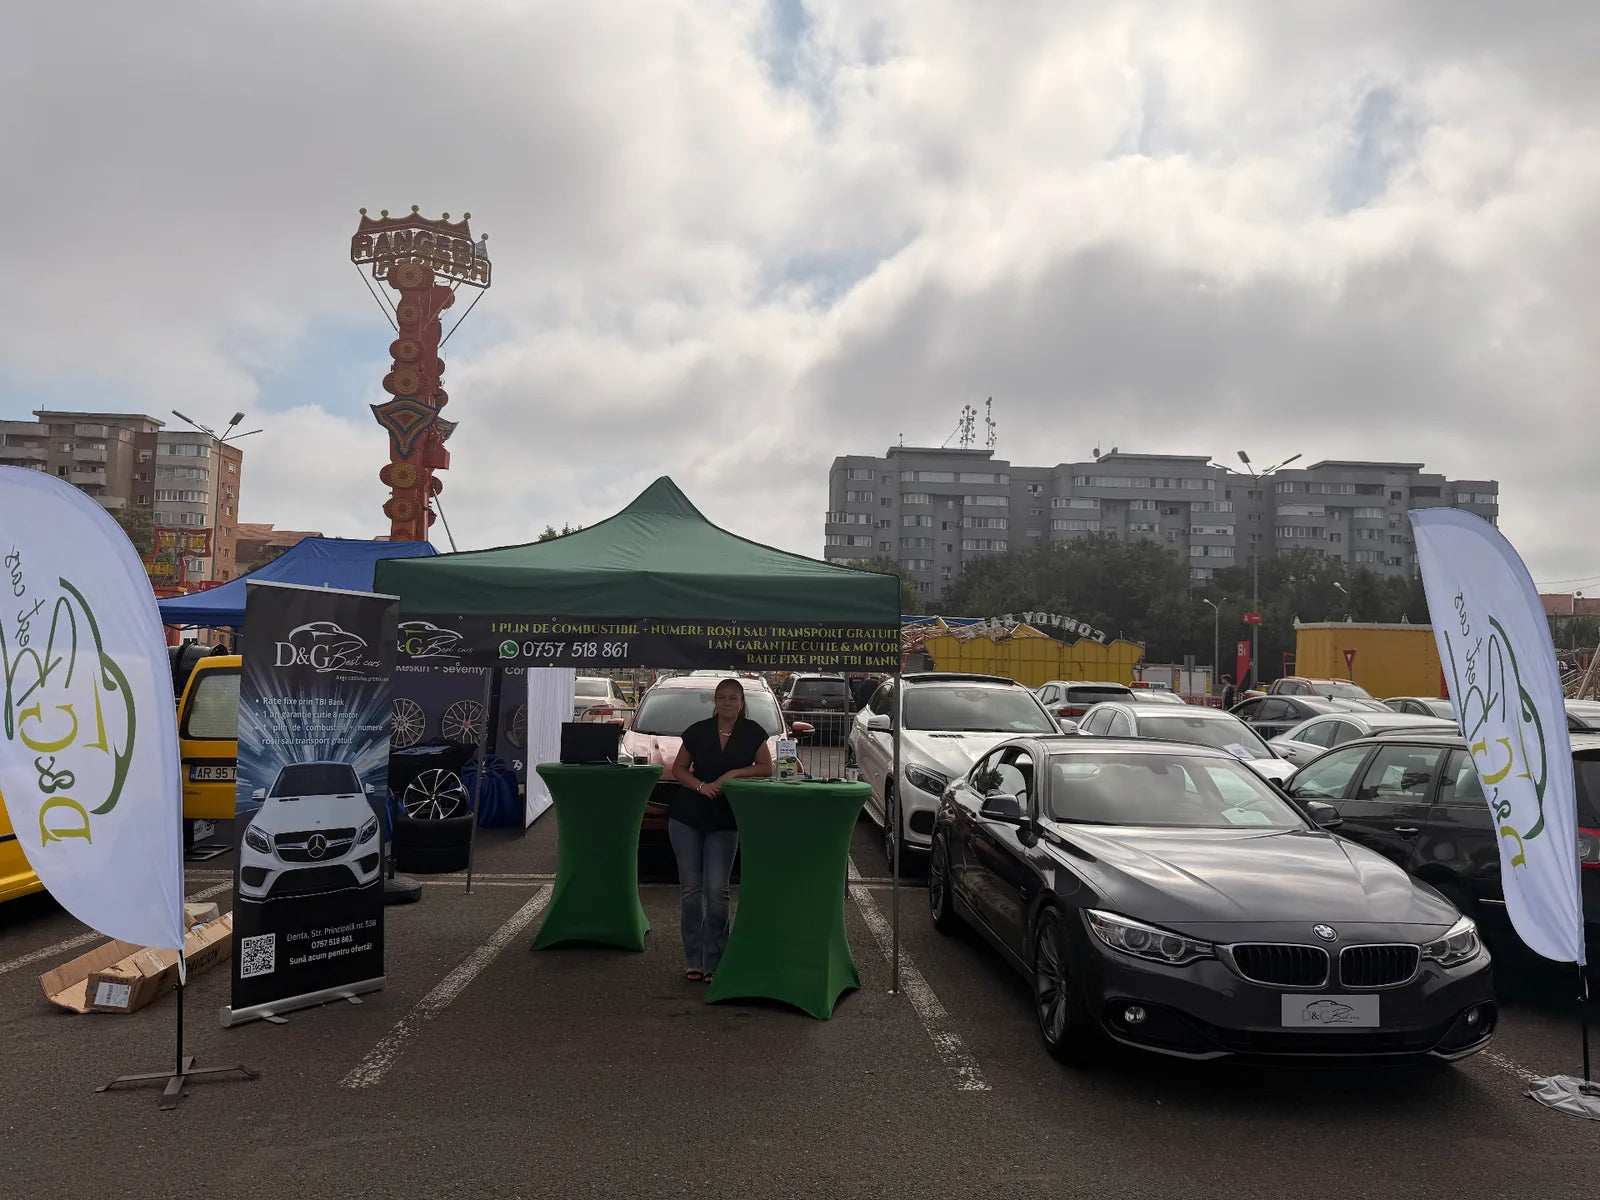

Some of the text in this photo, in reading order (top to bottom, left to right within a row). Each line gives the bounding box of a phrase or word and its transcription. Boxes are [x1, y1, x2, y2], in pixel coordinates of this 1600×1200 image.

[533, 623, 549, 634] DE
[552, 624, 640, 634] COMBUSTIBIL
[651, 626, 704, 636] NUMERE
[744, 627, 767, 637] SAU
[770, 628, 844, 638] TRANSPORT
[846, 629, 899, 639] GRATUIT
[522, 641, 628, 658] 0757 518 861
[715, 640, 733, 649] AN
[801, 642, 838, 652] CUTIE
[840, 643, 850, 652] &
[853, 642, 899, 653] MOTOR
[273, 641, 382, 673] D&G Best cars
[747, 654, 898, 666] RATE FIXE PRIN TBI BANK
[263, 697, 282, 705] Rate
[283, 697, 297, 705] fixe
[298, 698, 313, 708] prin
[292, 724, 301, 732] de
[197, 768, 212, 778] AR
[215, 768, 228, 779] 95
[311, 935, 353, 949] 0757 518 861
[308, 953, 327, 963] acum
[328, 948, 350, 959] pentru
